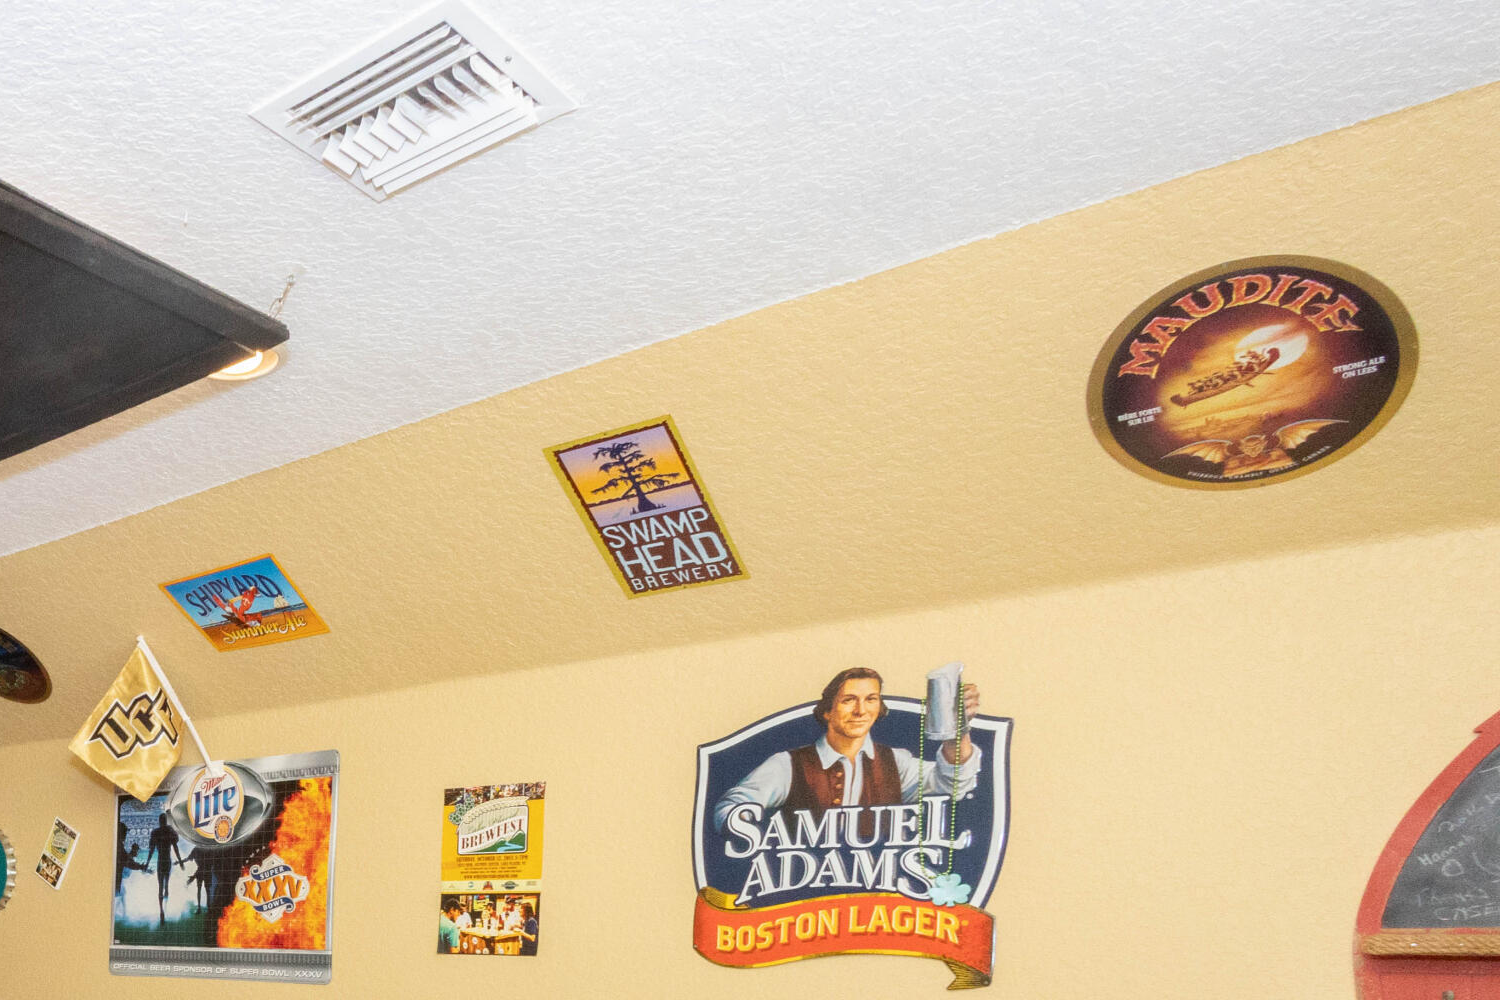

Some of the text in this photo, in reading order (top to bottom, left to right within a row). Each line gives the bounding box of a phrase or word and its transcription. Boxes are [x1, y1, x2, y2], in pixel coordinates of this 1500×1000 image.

[1117, 273, 1363, 380] MAUDITE
[1332, 355, 1386, 375] STRONG ALE
[1341, 366, 1378, 379] ON LEES
[602, 507, 710, 549] SWAMP
[615, 531, 728, 579] HEAD
[630, 561, 735, 591] BREWERY
[185, 573, 284, 617] SHIPYARD
[222, 614, 307, 645] Summer Ale
[85, 688, 179, 760] UCF
[193, 785, 237, 829] Lite
[460, 818, 525, 850] BREWFEST
[724, 793, 971, 860] SAMUEL
[243, 874, 302, 903] XXXV
[259, 866, 285, 880] SUPER
[735, 846, 943, 906] ADAMS
[262, 898, 285, 911] BOWL
[715, 903, 960, 953] BOSTON LAGER
[113, 962, 323, 978] OFFICIAL BEER SPONSOR OF SUPER BOWL XXXV
